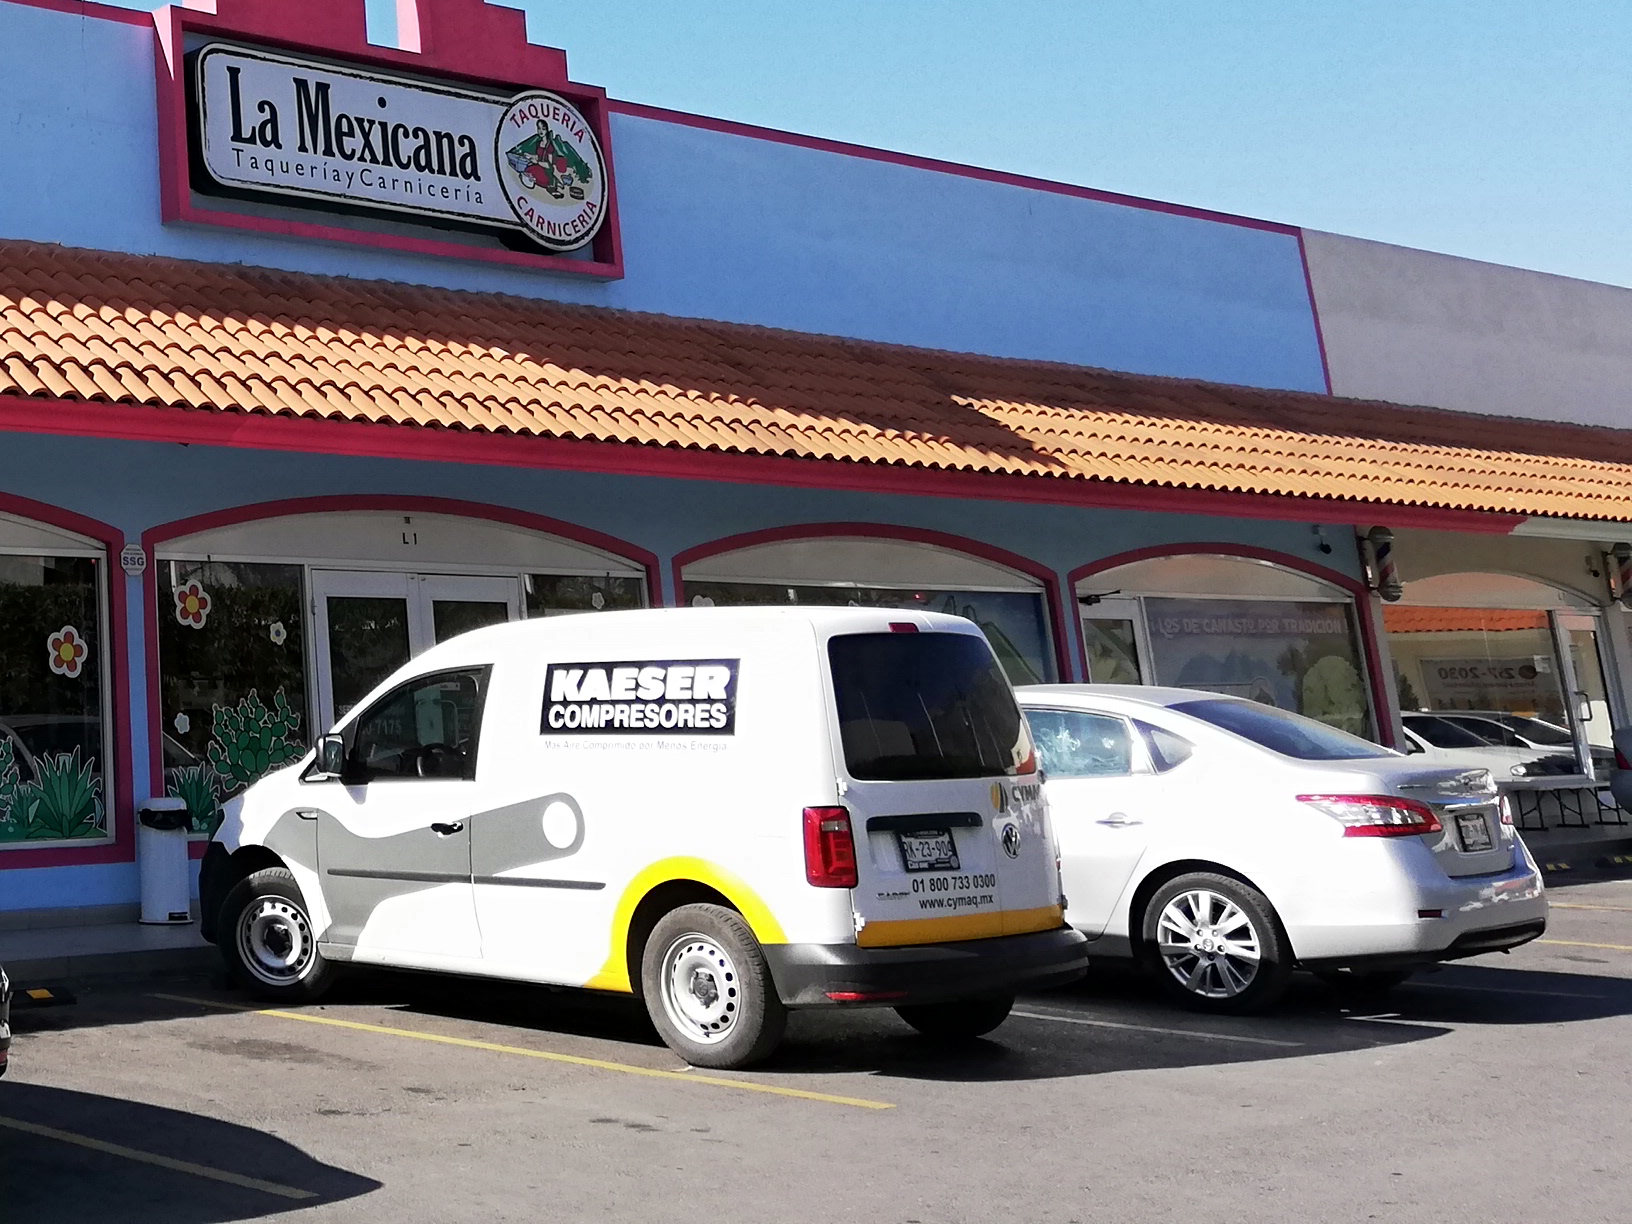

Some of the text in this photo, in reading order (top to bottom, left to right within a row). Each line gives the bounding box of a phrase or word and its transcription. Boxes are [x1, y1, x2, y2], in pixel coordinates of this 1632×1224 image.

[226, 66, 482, 182] La Mexicana
[509, 103, 586, 144] TAQUERIA
[517, 196, 598, 238] CARNICERIA
[122, 556, 145, 567] SSG
[1183, 618, 1201, 634] DE
[549, 666, 731, 702] KAESER
[548, 702, 728, 729] COMPRESORES
[657, 740, 687, 751] Menos
[912, 874, 996, 893] 01 800 733 0300
[919, 893, 994, 911] www.cymaq.mx
